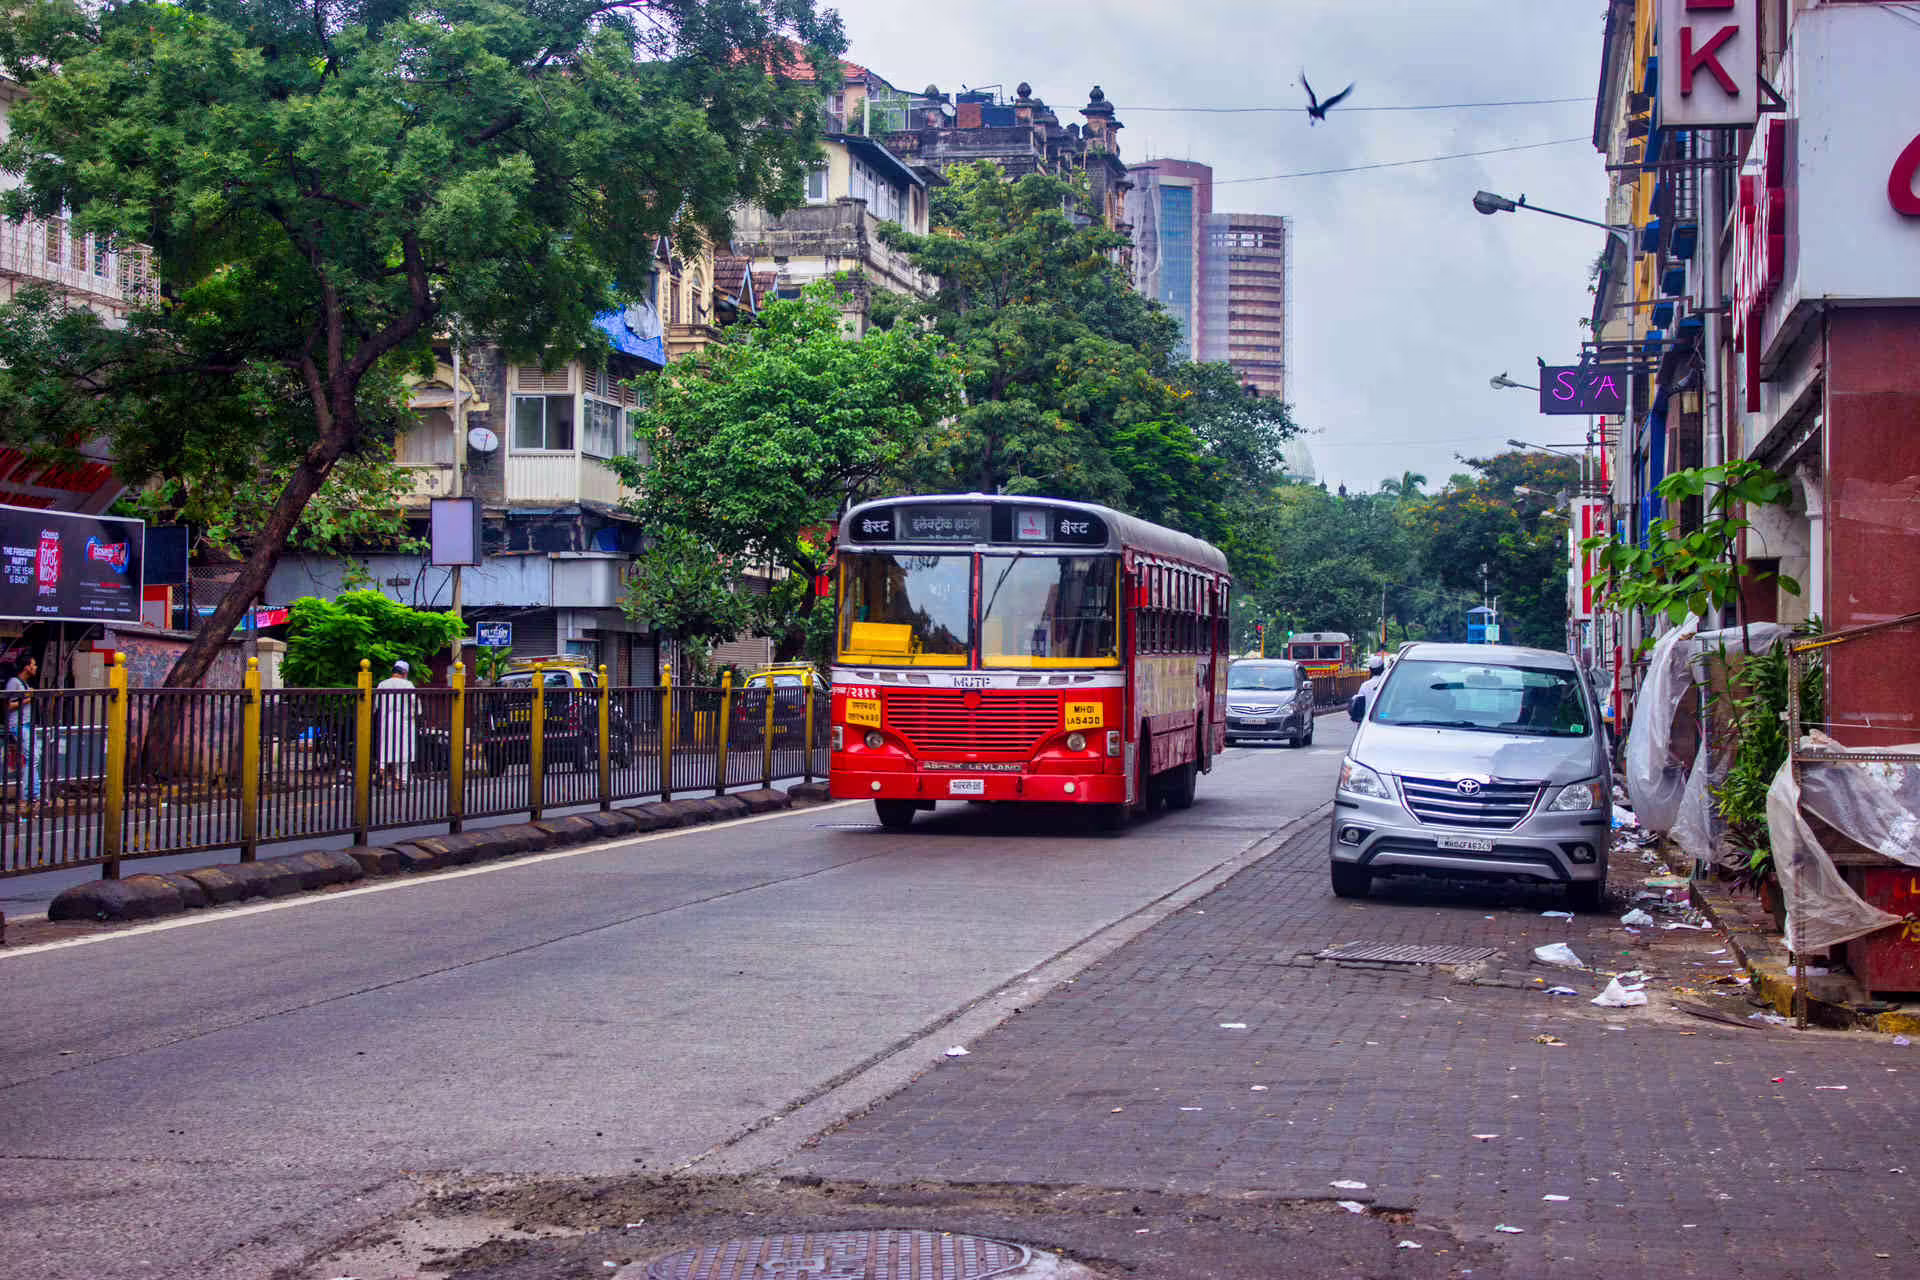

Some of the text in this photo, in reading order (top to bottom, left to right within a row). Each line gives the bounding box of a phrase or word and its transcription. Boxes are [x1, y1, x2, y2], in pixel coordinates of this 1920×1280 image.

[1680, 0, 1741, 98] K
[863, 519, 890, 533] बेस्ट
[1060, 519, 1089, 535] बेस्ट
[12, 566, 21, 574] THE
[967, 763, 1023, 771] LEYLAND
